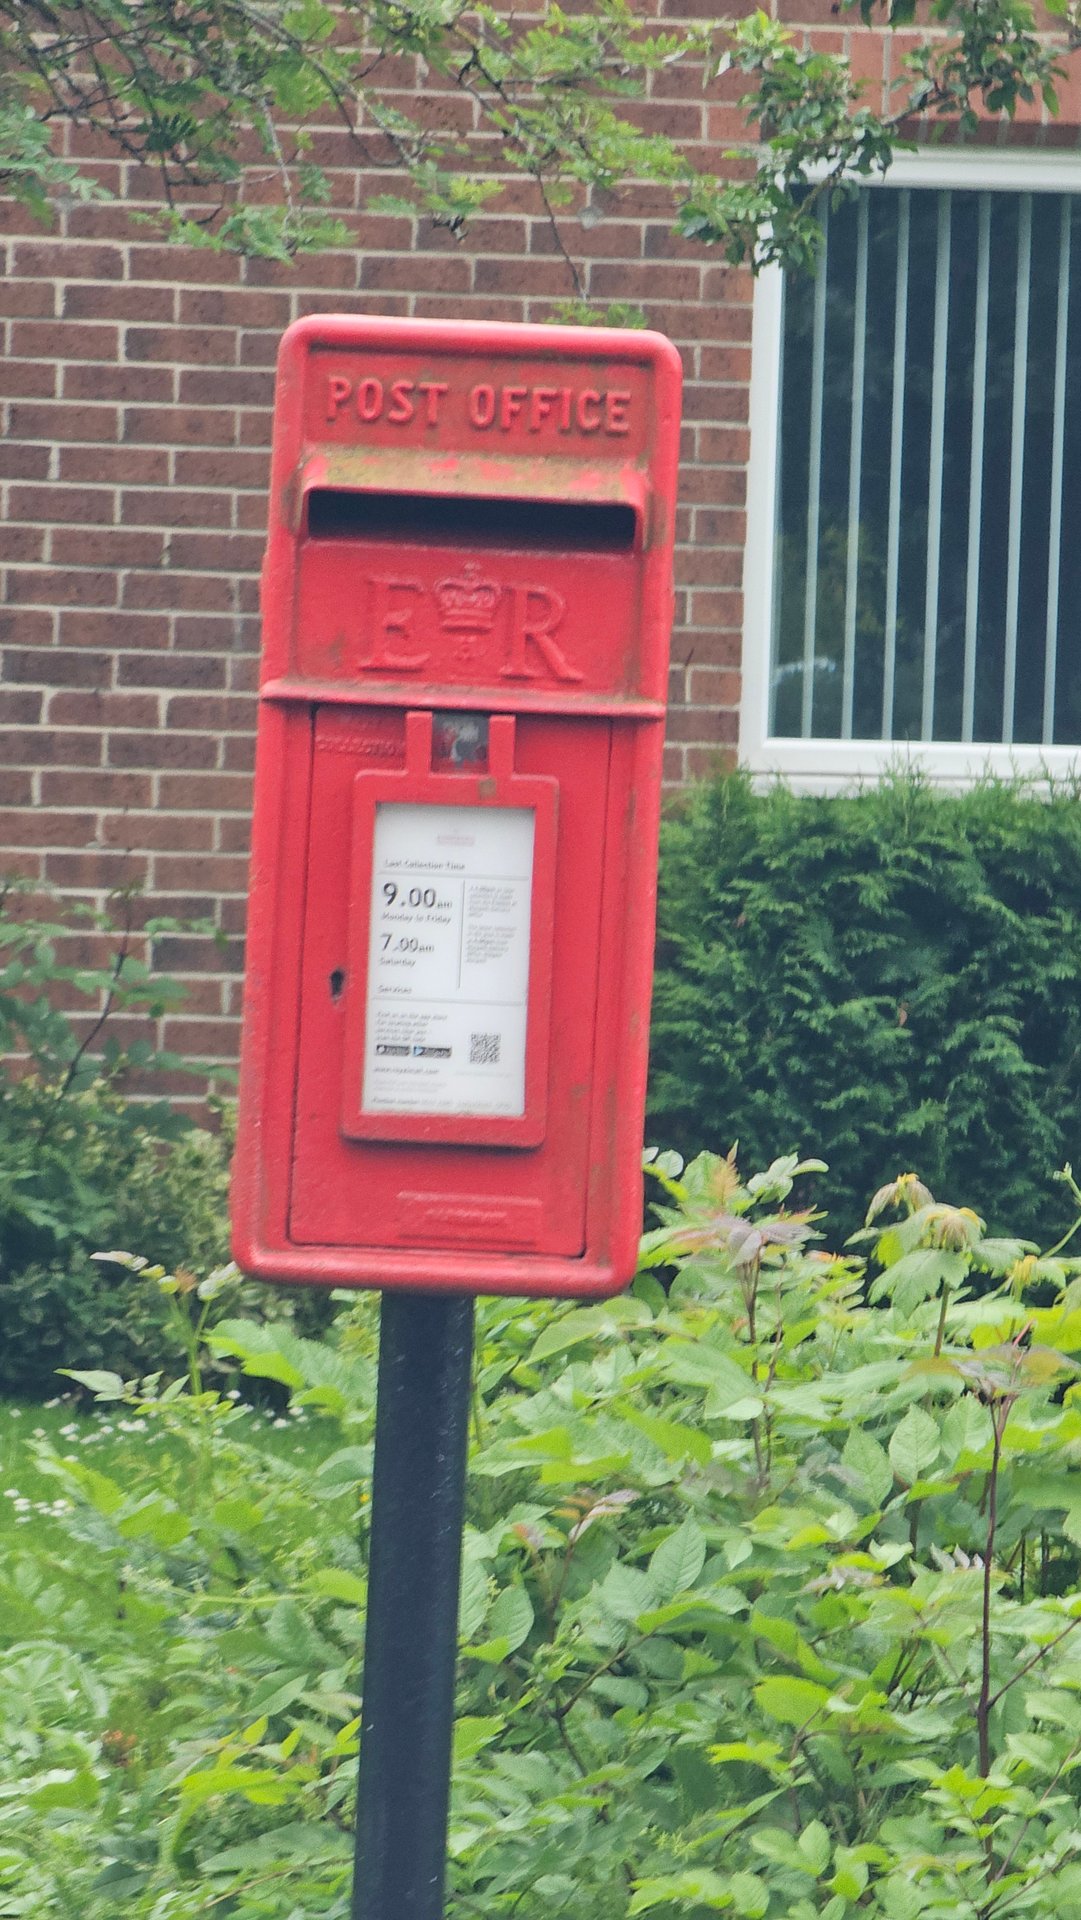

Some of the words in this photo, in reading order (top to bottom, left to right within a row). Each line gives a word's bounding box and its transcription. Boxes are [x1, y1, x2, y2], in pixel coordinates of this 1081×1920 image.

[326, 375, 448, 427] POST
[467, 383, 632, 436] OFFICE
[357, 574, 431, 673] E
[499, 582, 583, 684] R
[381, 912, 413, 923] Monday
[415, 914, 425, 922] to
[426, 914, 452, 925] Friday
[379, 957, 417, 967] Saturday
